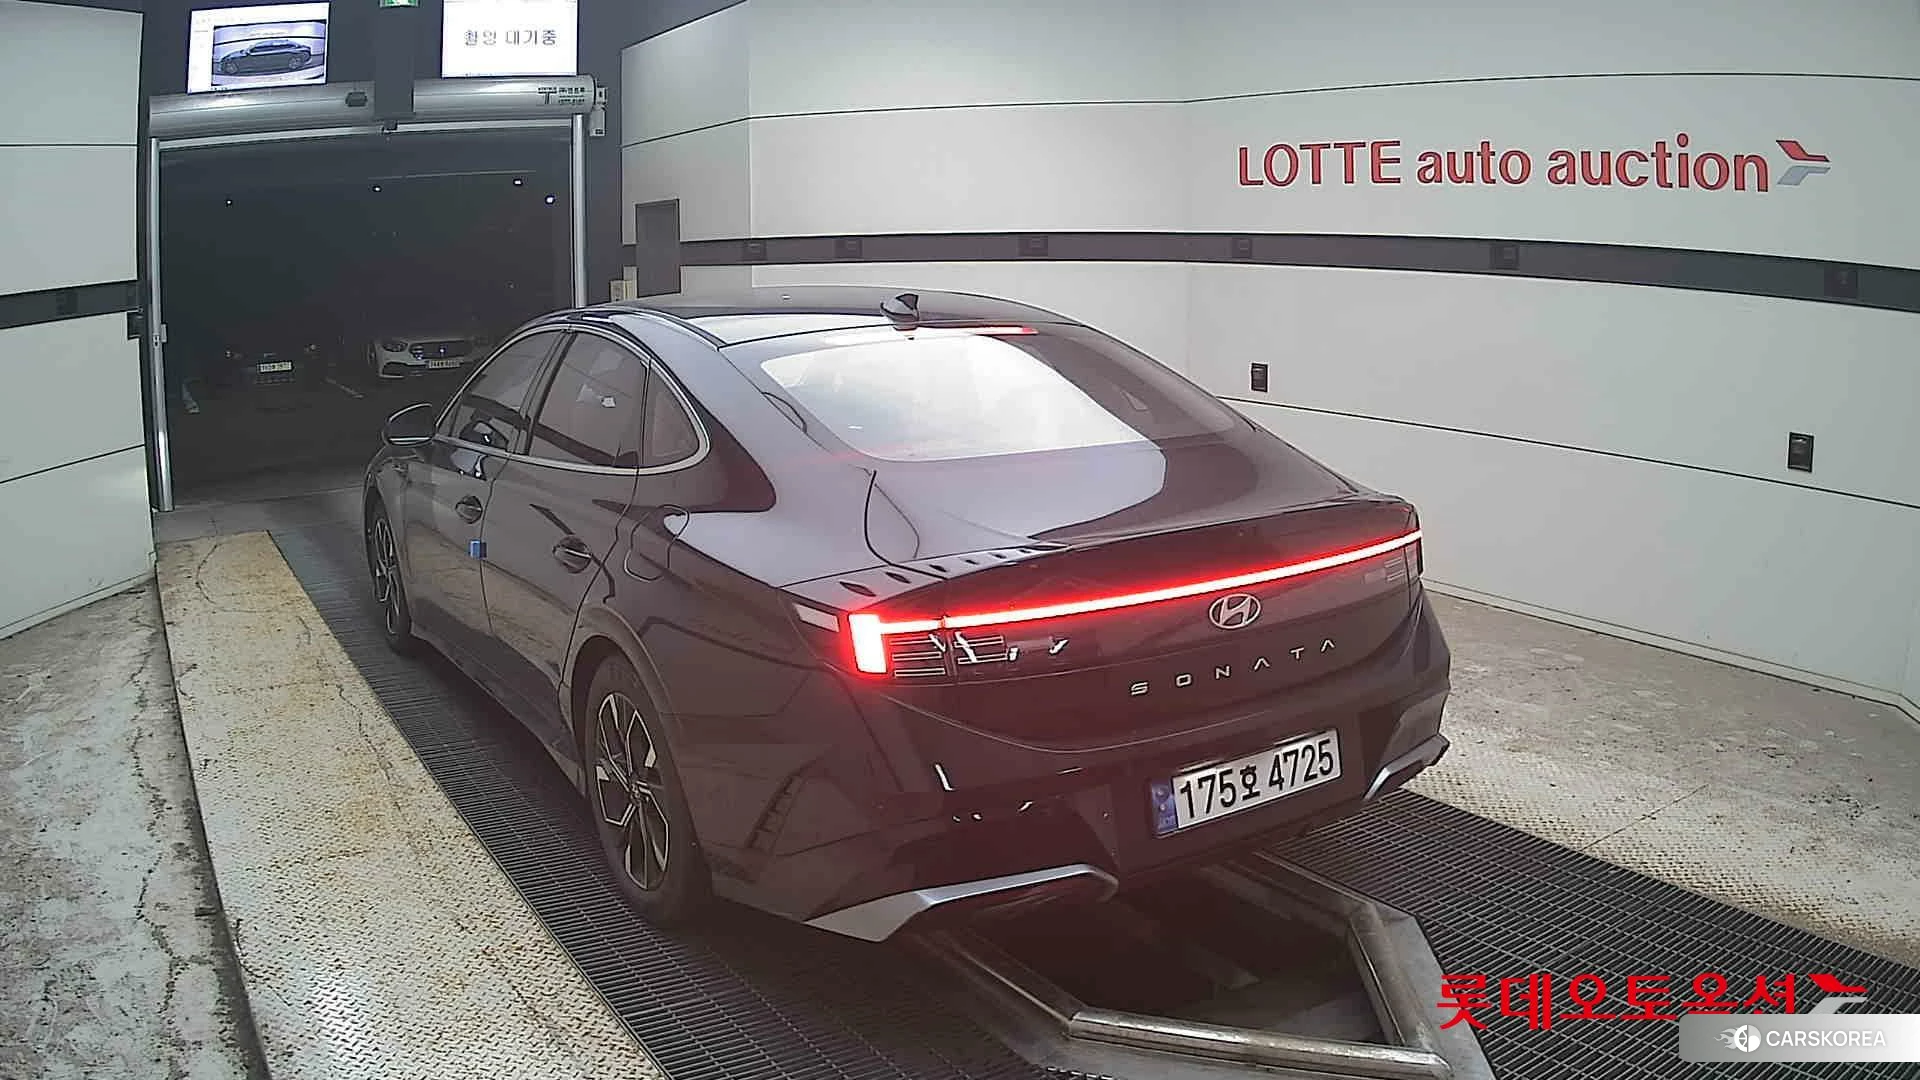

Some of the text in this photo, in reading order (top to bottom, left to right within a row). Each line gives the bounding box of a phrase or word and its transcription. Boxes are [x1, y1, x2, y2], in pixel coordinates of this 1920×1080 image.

[504, 28, 557, 47] 대기중
[1239, 134, 1768, 192] LOTTE auto auction
[1130, 638, 1336, 696] SONATA
[1180, 738, 1334, 819] 175호 4725
